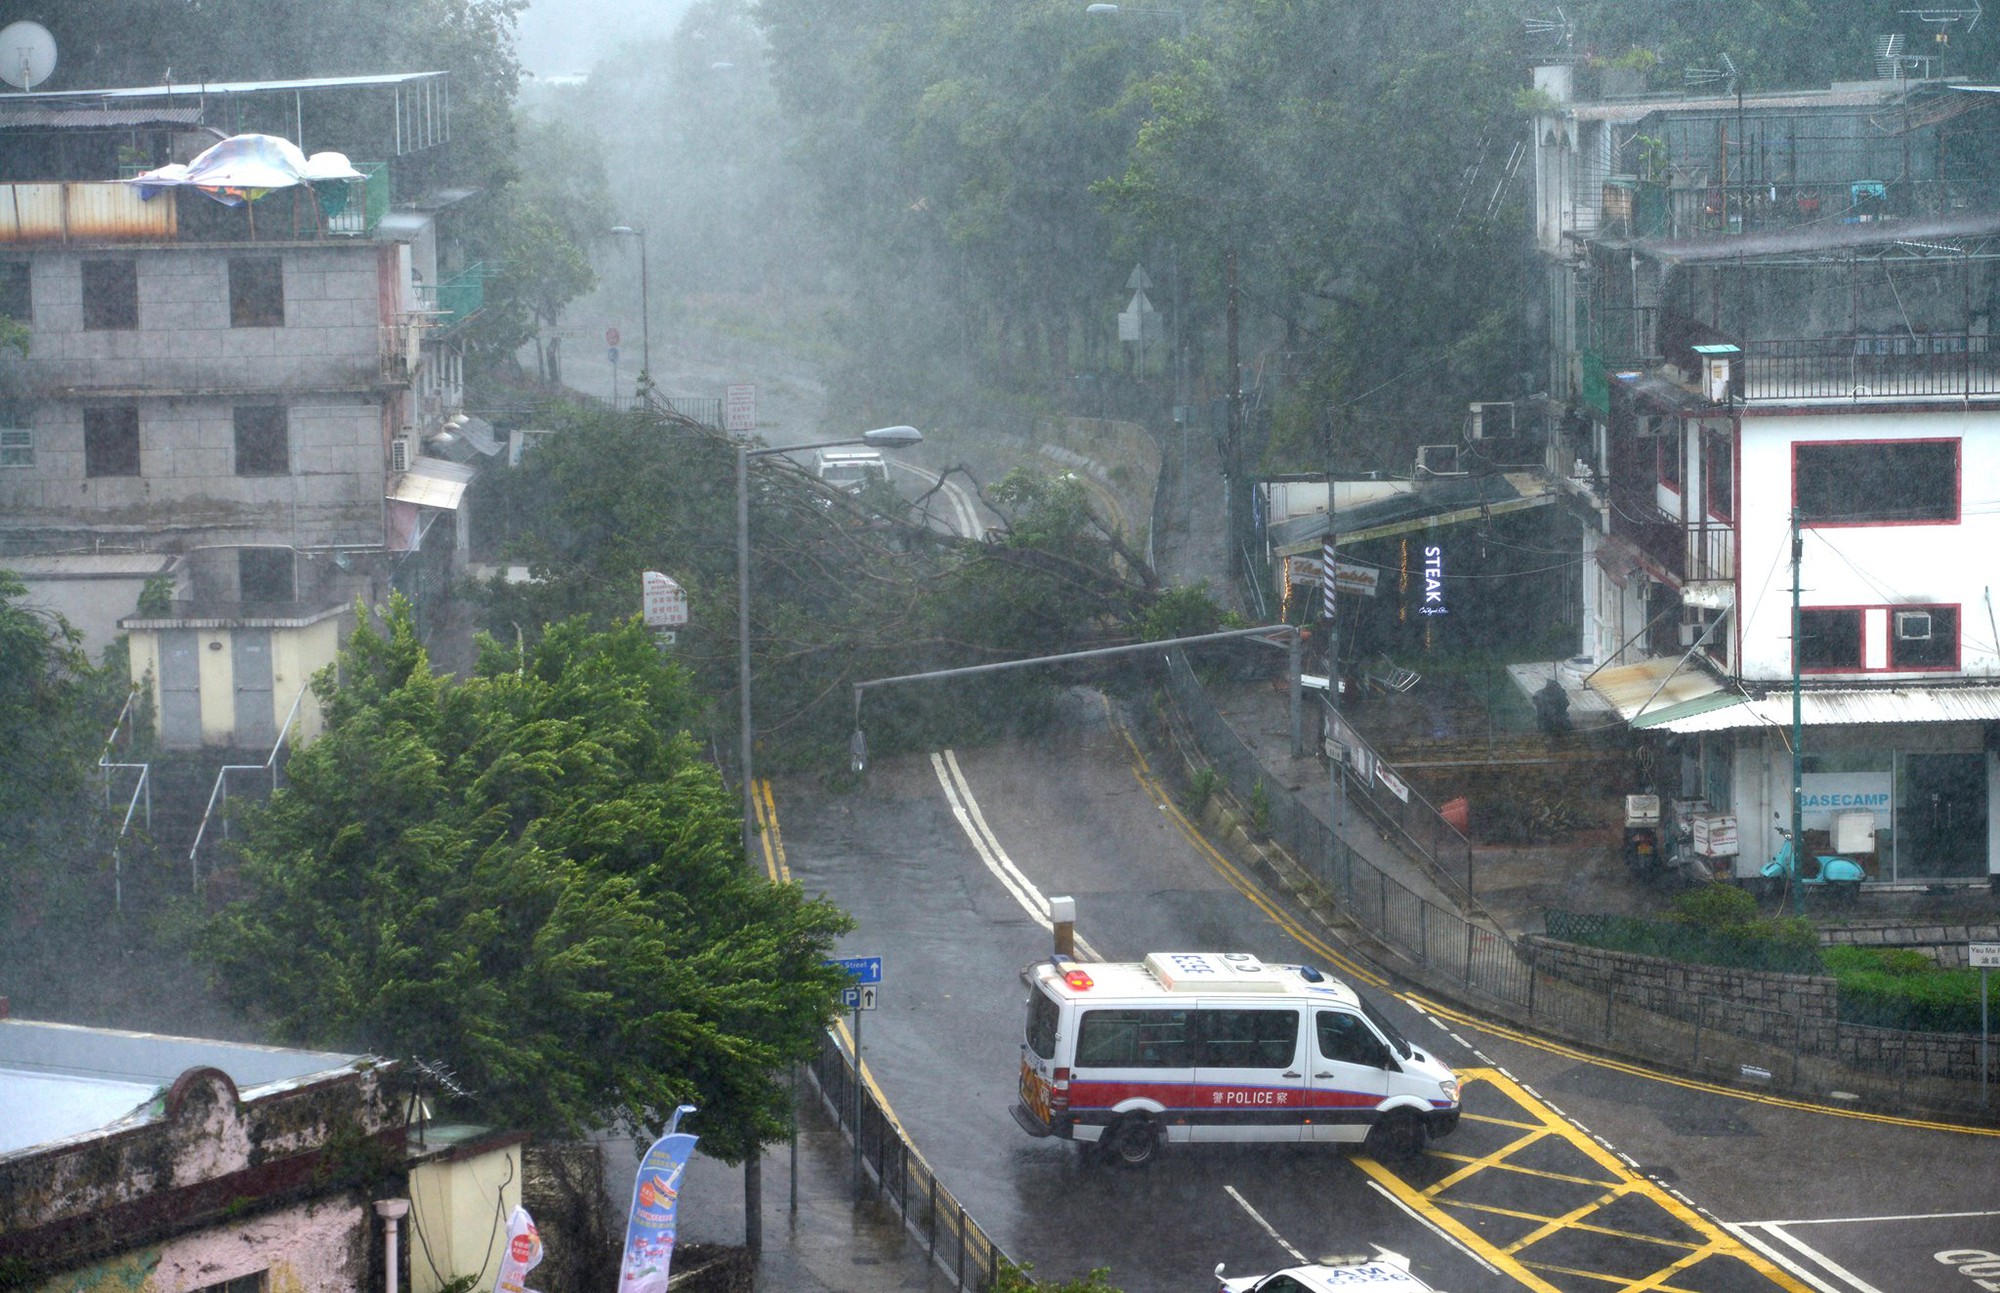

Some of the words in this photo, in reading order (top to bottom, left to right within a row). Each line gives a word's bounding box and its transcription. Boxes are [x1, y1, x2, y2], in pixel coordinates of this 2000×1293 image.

[1425, 546, 1441, 602] STEAK
[1801, 793, 1889, 806] BASECAMP
[846, 991, 857, 1007] P
[1212, 1091, 1224, 1104] 警
[1227, 1091, 1273, 1104] POLICE
[1276, 1091, 1288, 1104] 察
[1333, 1266, 1386, 1277] AM
